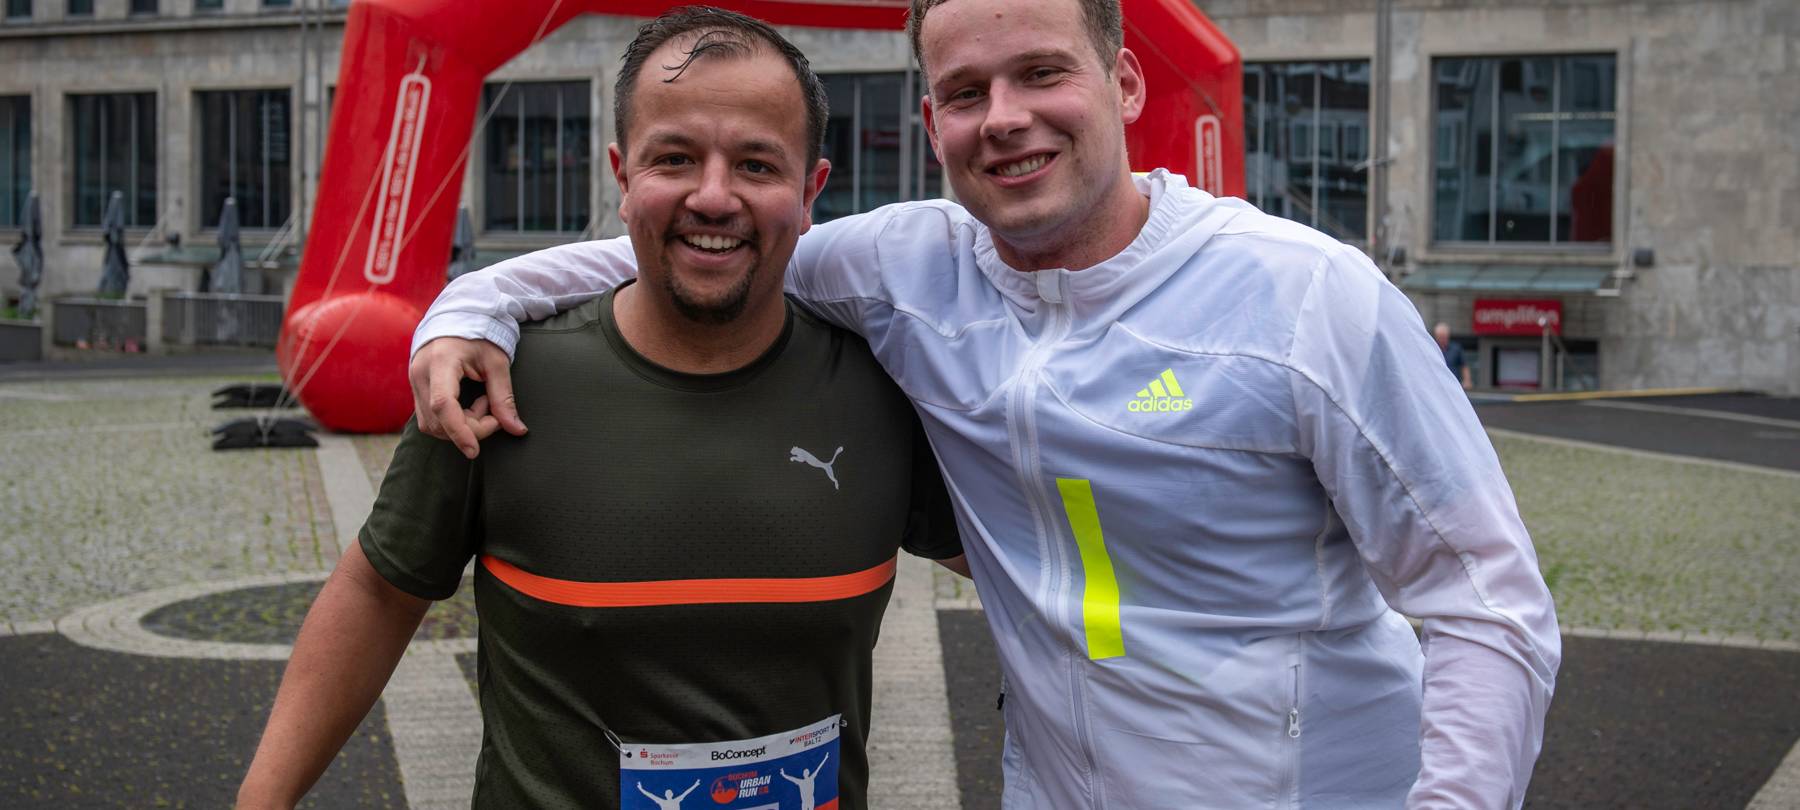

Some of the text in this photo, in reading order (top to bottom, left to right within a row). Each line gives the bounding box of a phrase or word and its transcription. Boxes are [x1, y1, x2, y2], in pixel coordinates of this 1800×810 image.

[1475, 305, 1559, 328] amplifon
[1127, 396, 1193, 412] adidas
[711, 746, 766, 760] BoConcept
[740, 774, 772, 789] URBAN
[738, 786, 758, 798] RUN
